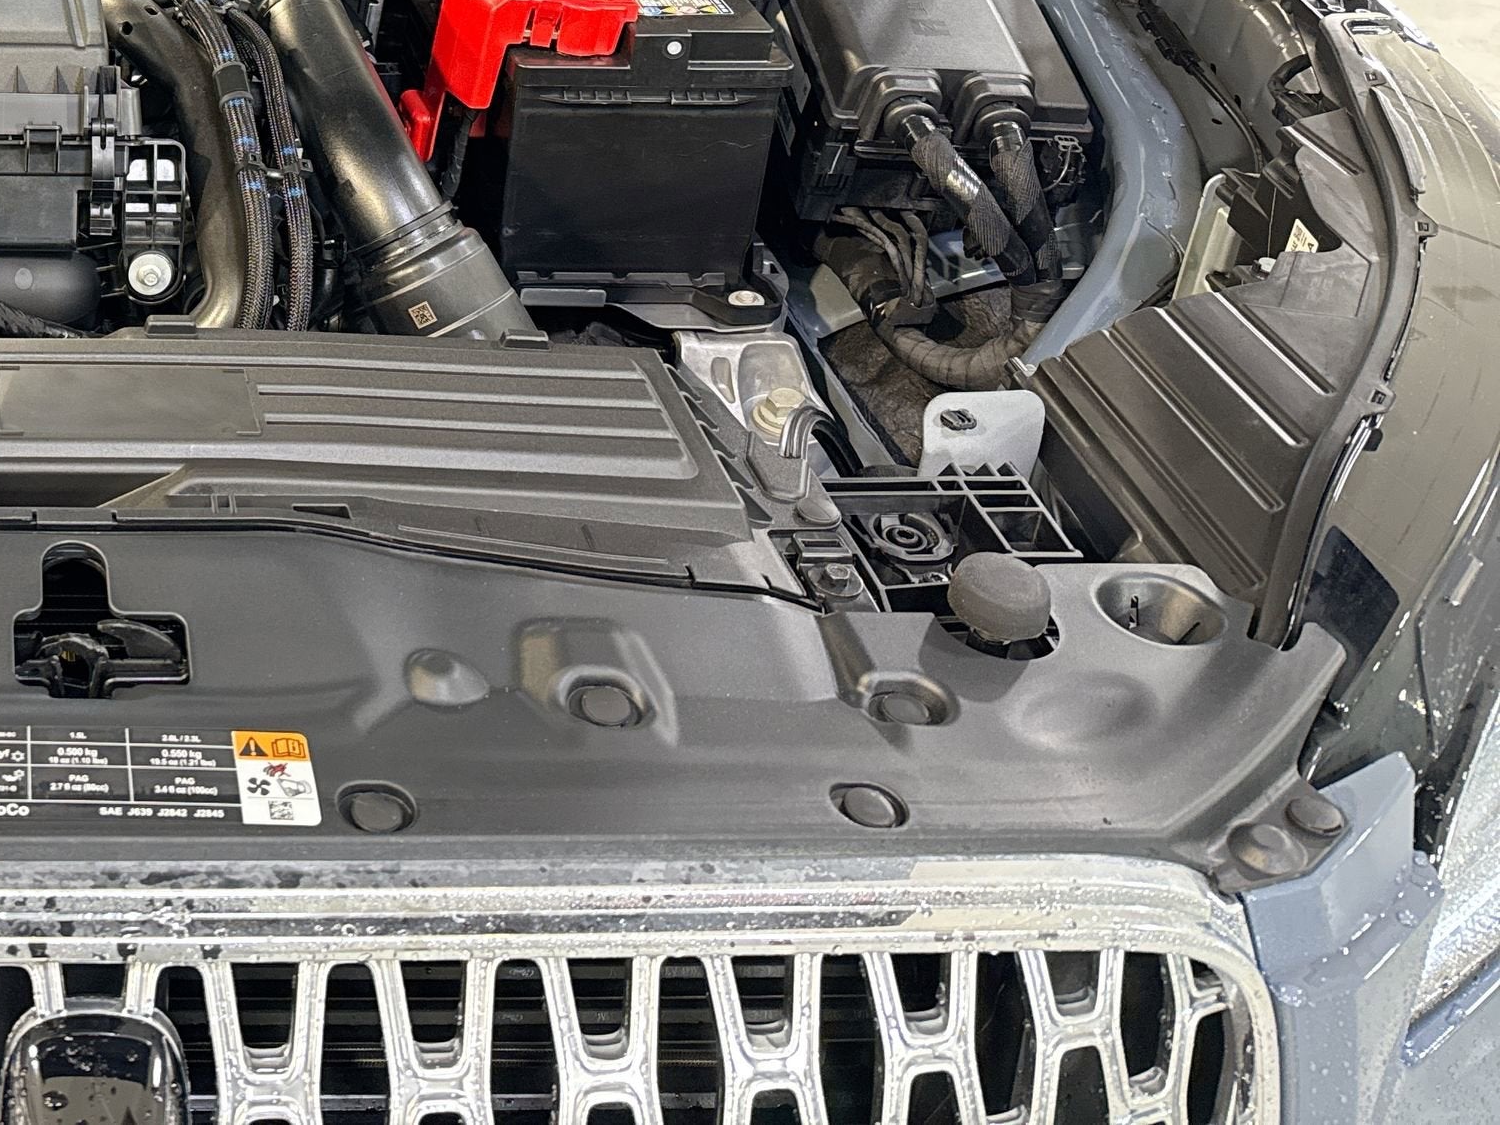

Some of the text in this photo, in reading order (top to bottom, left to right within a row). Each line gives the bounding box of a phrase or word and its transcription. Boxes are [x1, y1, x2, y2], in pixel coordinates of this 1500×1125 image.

[85, 748, 98, 758] kg
[161, 749, 202, 760] 0.550 kg
[174, 777, 195, 785] PAG
[99, 807, 225, 818] SAE J639 J2842 J2845
